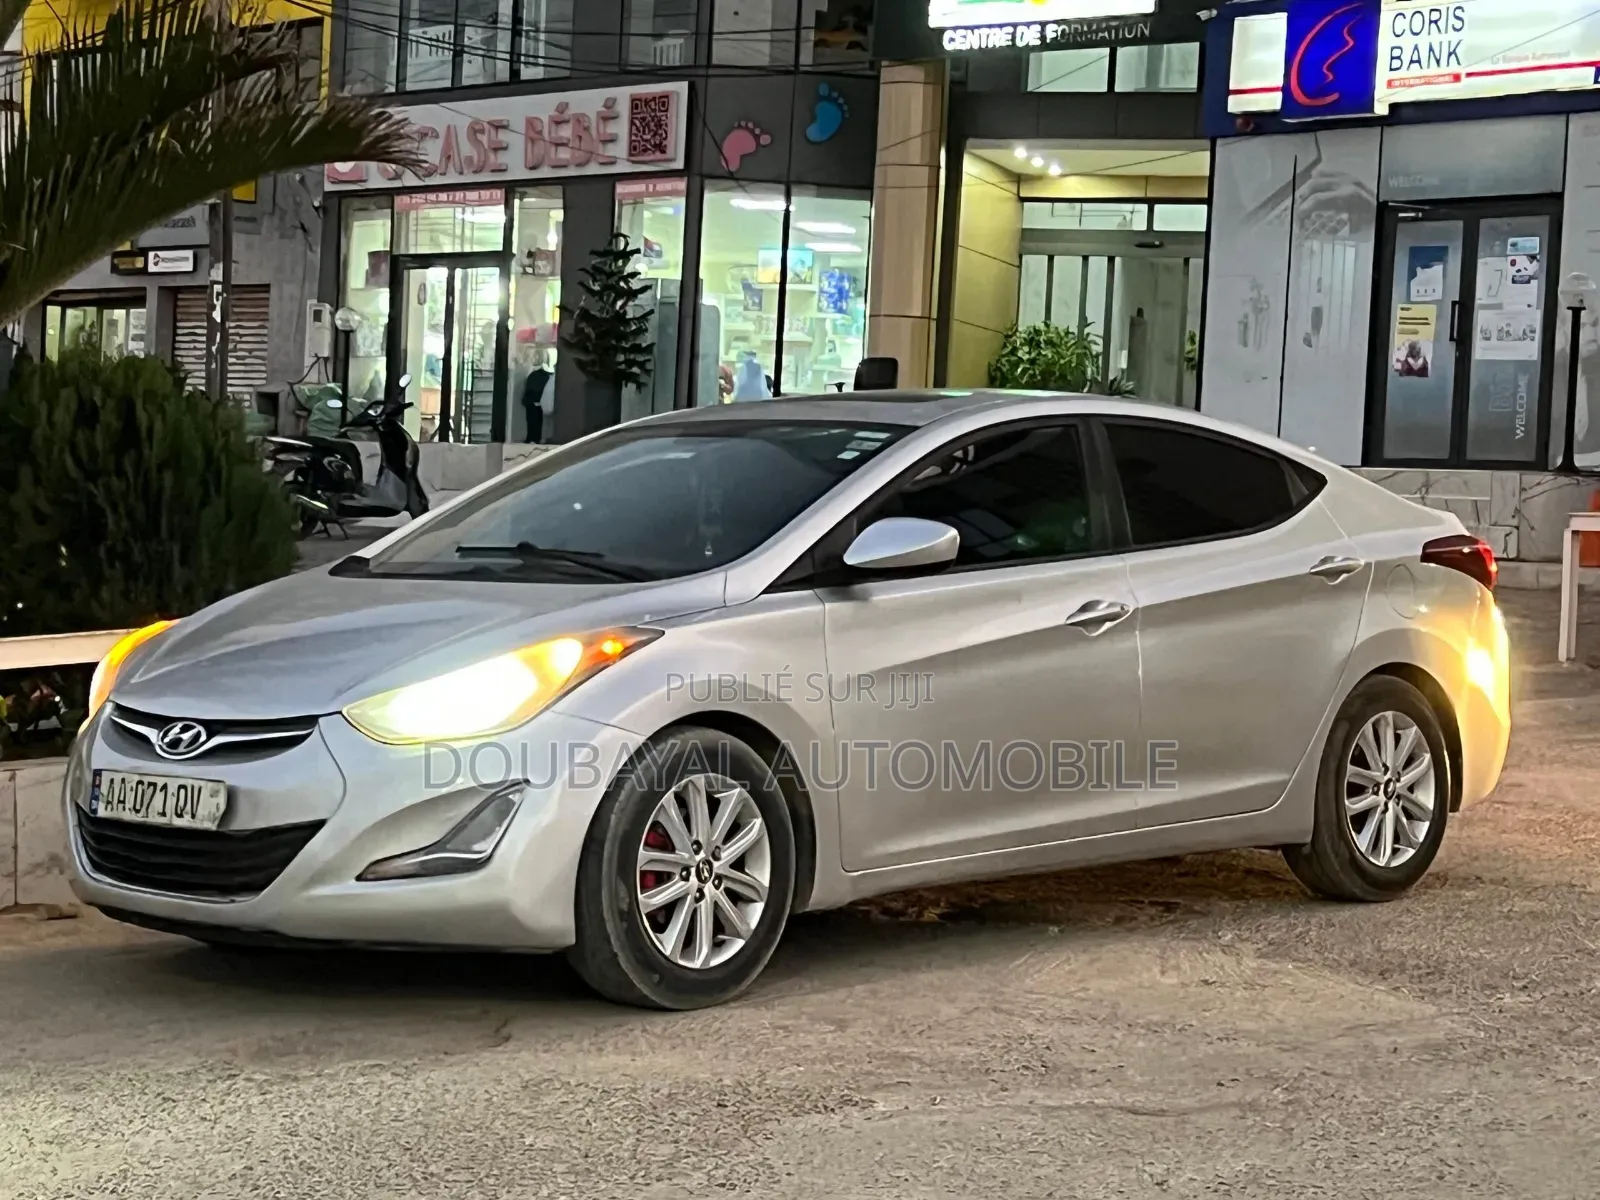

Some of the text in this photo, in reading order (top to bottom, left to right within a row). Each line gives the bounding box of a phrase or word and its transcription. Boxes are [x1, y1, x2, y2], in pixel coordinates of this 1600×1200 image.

[942, 21, 1151, 50] CENTRE DE FORMATION
[1391, 5, 1465, 38] CORIS
[1389, 39, 1464, 72] BANK
[524, 97, 619, 170] BÉBÉ
